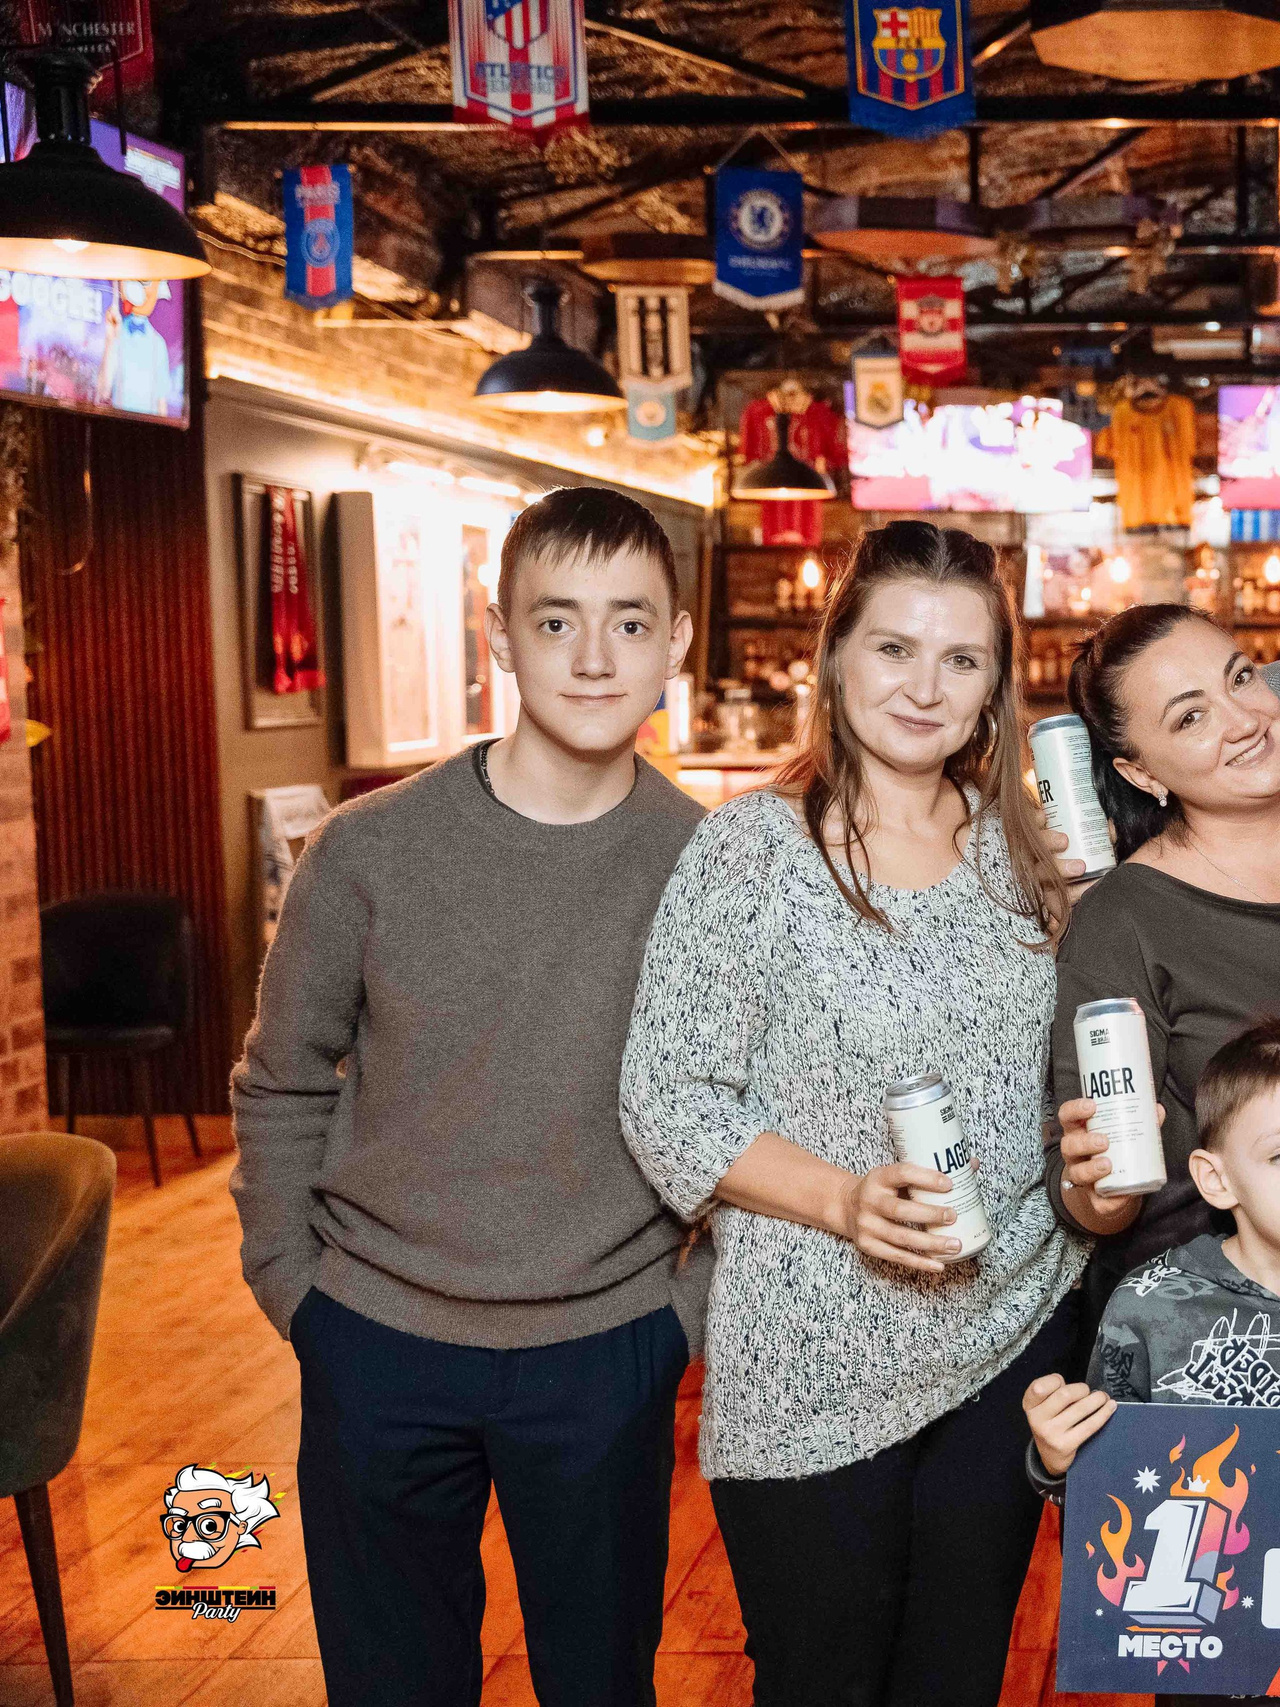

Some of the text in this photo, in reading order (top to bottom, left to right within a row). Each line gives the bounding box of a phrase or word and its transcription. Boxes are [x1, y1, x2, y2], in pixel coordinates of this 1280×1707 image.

[38, 22, 135, 37] MNCHESTER
[1082, 1067, 1136, 1099] LAGER
[1117, 1635, 1224, 1659] МЕСТО
